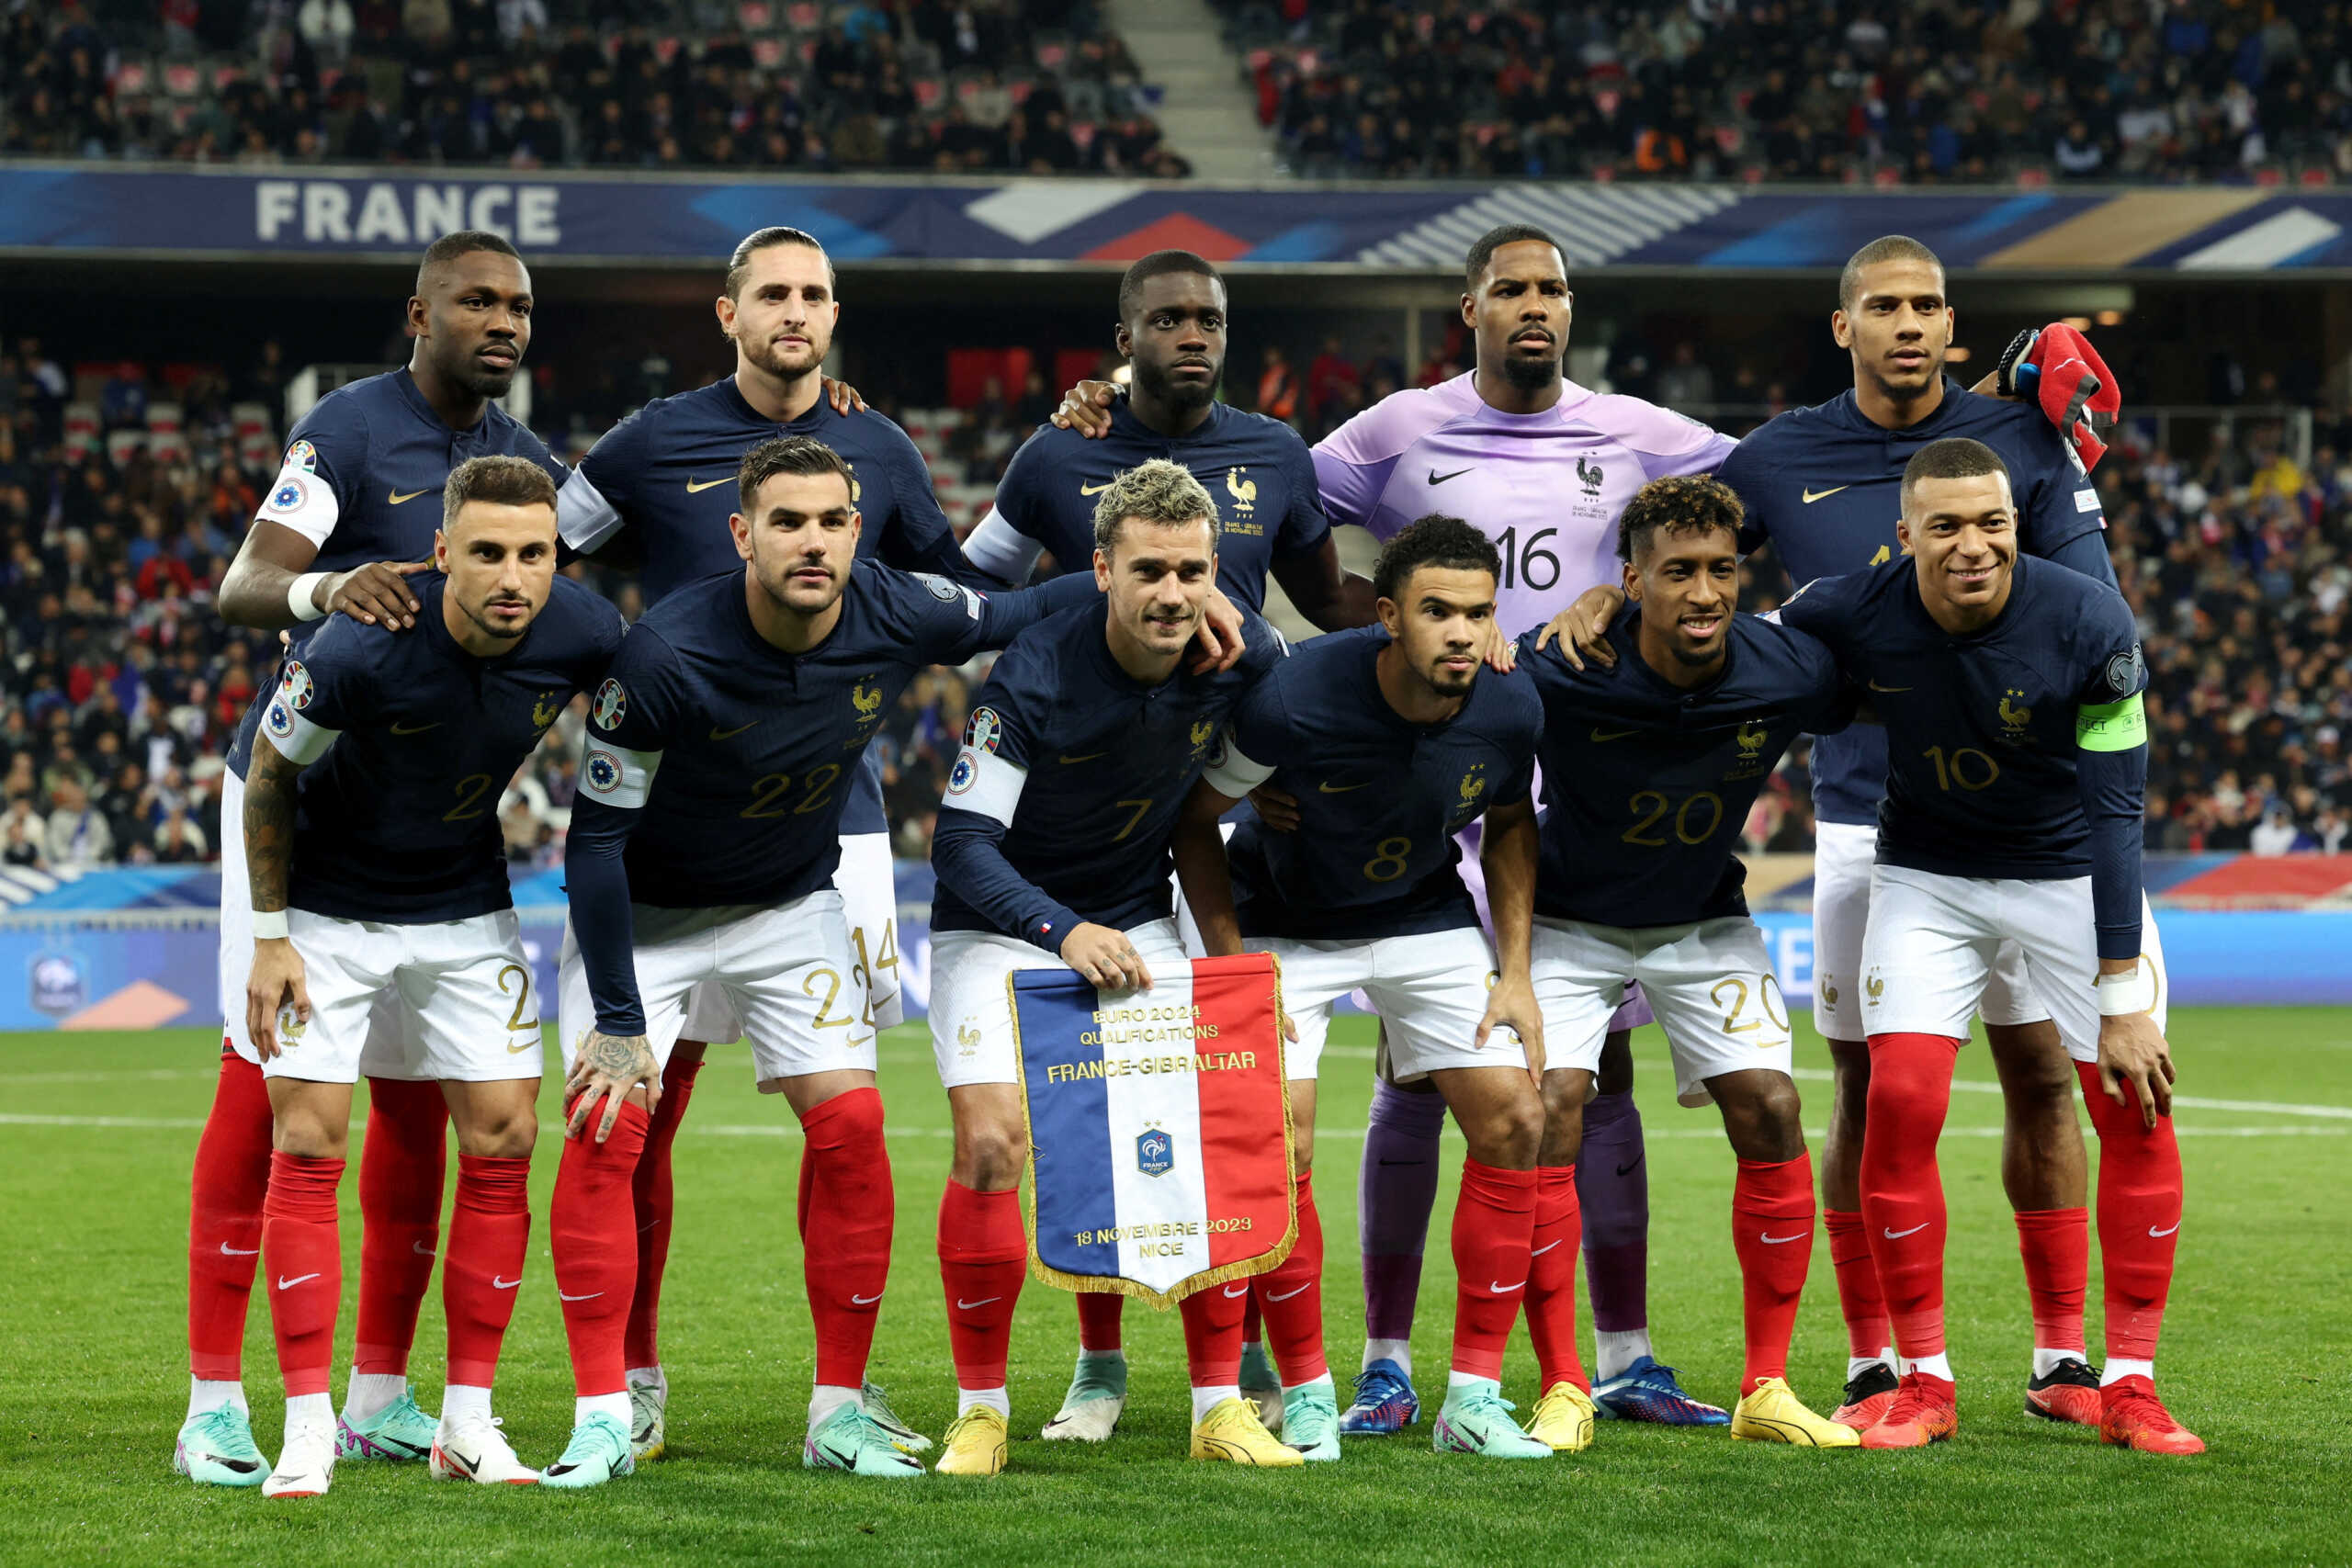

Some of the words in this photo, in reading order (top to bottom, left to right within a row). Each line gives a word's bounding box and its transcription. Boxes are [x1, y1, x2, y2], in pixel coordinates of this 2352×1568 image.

[256, 181, 561, 245] FRANCE
[1497, 525, 1561, 592] 16
[740, 763, 842, 818] 22
[1923, 745, 2000, 792] 10
[442, 773, 492, 822] 2
[1112, 798, 1154, 842] 7
[1622, 790, 1724, 846] 20
[1363, 836, 1412, 883] 8
[851, 918, 899, 990] 14
[497, 964, 538, 1032] 2
[1091, 1008, 1147, 1024] EURO
[1150, 1004, 1202, 1021] 2024
[1710, 974, 1790, 1034] 20
[1080, 1023, 1219, 1046] QUALIFICATIONS
[1046, 1051, 1257, 1084] FRANCE-GIBRALTAR
[1143, 1161, 1169, 1169] FRANCE
[1073, 1231, 1092, 1247] 18
[1097, 1221, 1199, 1245] NOVEMBRE
[1204, 1216, 1253, 1235] 2023
[1139, 1241, 1184, 1258] NICE
